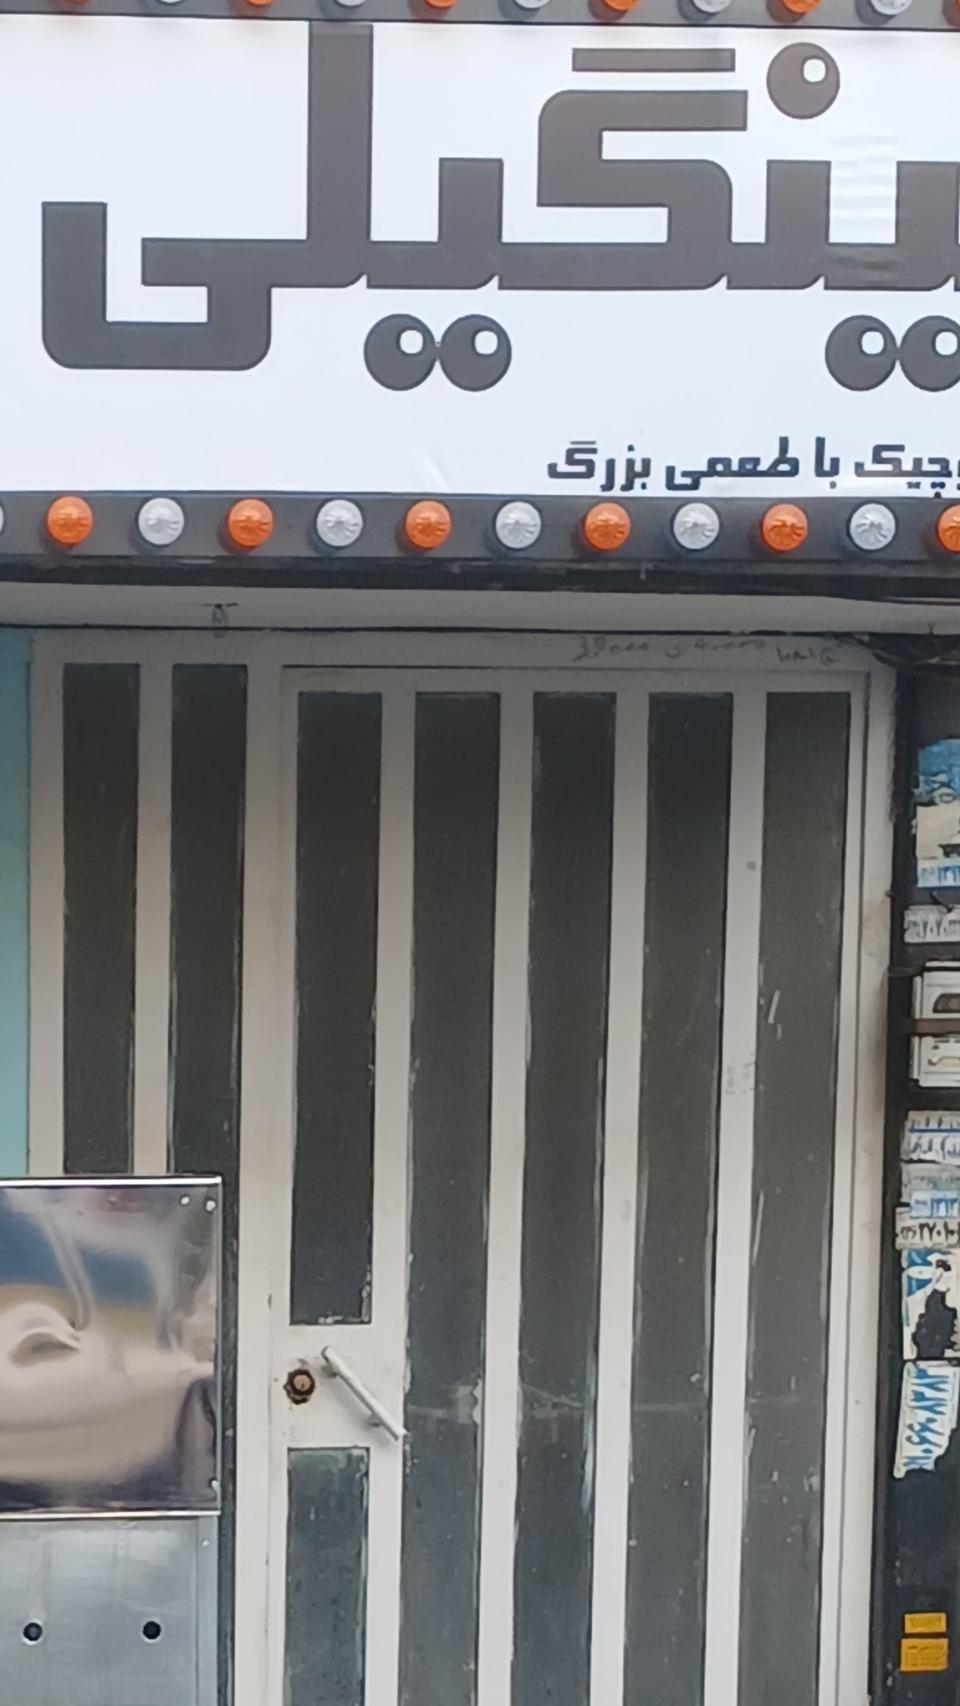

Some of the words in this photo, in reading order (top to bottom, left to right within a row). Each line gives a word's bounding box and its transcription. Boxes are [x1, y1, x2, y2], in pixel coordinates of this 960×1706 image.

[41, 21, 960, 392] ینگیلی
[546, 440, 652, 493] بزرگ
[665, 435, 800, 492] طعمی
[814, 436, 841, 491] با
[853, 443, 960, 498] چیک
